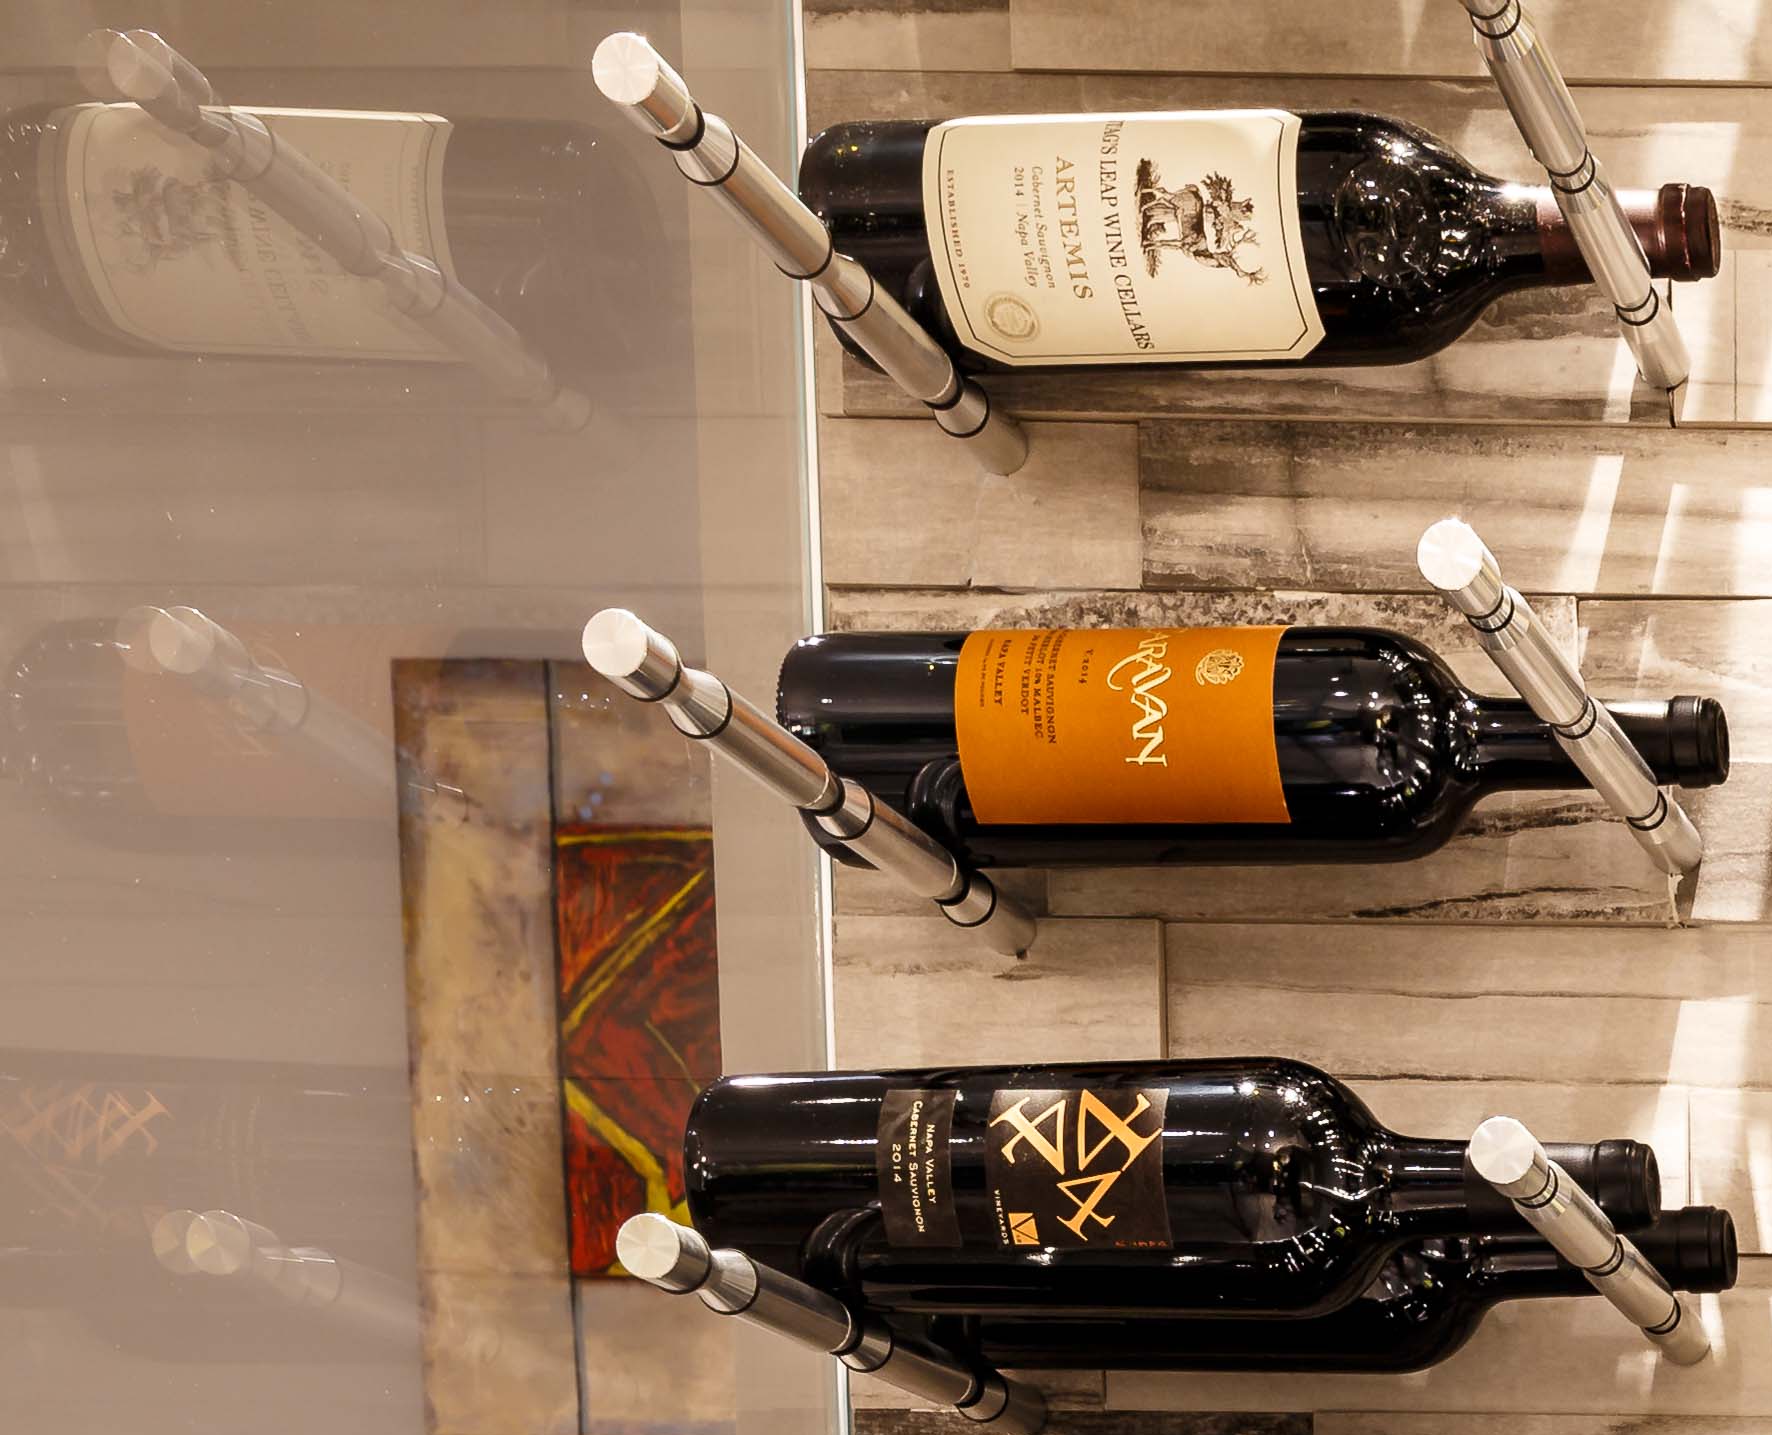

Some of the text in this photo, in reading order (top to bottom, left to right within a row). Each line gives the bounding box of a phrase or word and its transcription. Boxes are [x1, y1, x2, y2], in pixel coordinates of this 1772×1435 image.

[947, 170, 963, 257] ESTABLISHED
[1014, 167, 1038, 287] 2014 Napa Valley
[1032, 167, 1056, 289] Cabernet Sauvignon
[1056, 156, 1094, 299] ARTEMIS
[1100, 121, 1154, 351] TAG'S LEAP WINE CELLARS
[994, 662, 1006, 706] VALLEY
[1020, 669, 1030, 715] VERDOT
[1033, 688, 1044, 739] MALBEC
[1046, 674, 1057, 744] SAUVIGNON
[1106, 631, 1172, 767] ARAVAN
[892, 1143, 902, 1183] 2014
[909, 1100, 925, 1233] CABERNET SAUVIGNON
[925, 1124, 936, 1204] NAPA VALLEY
[994, 1189, 1009, 1245] VINEYARDS
